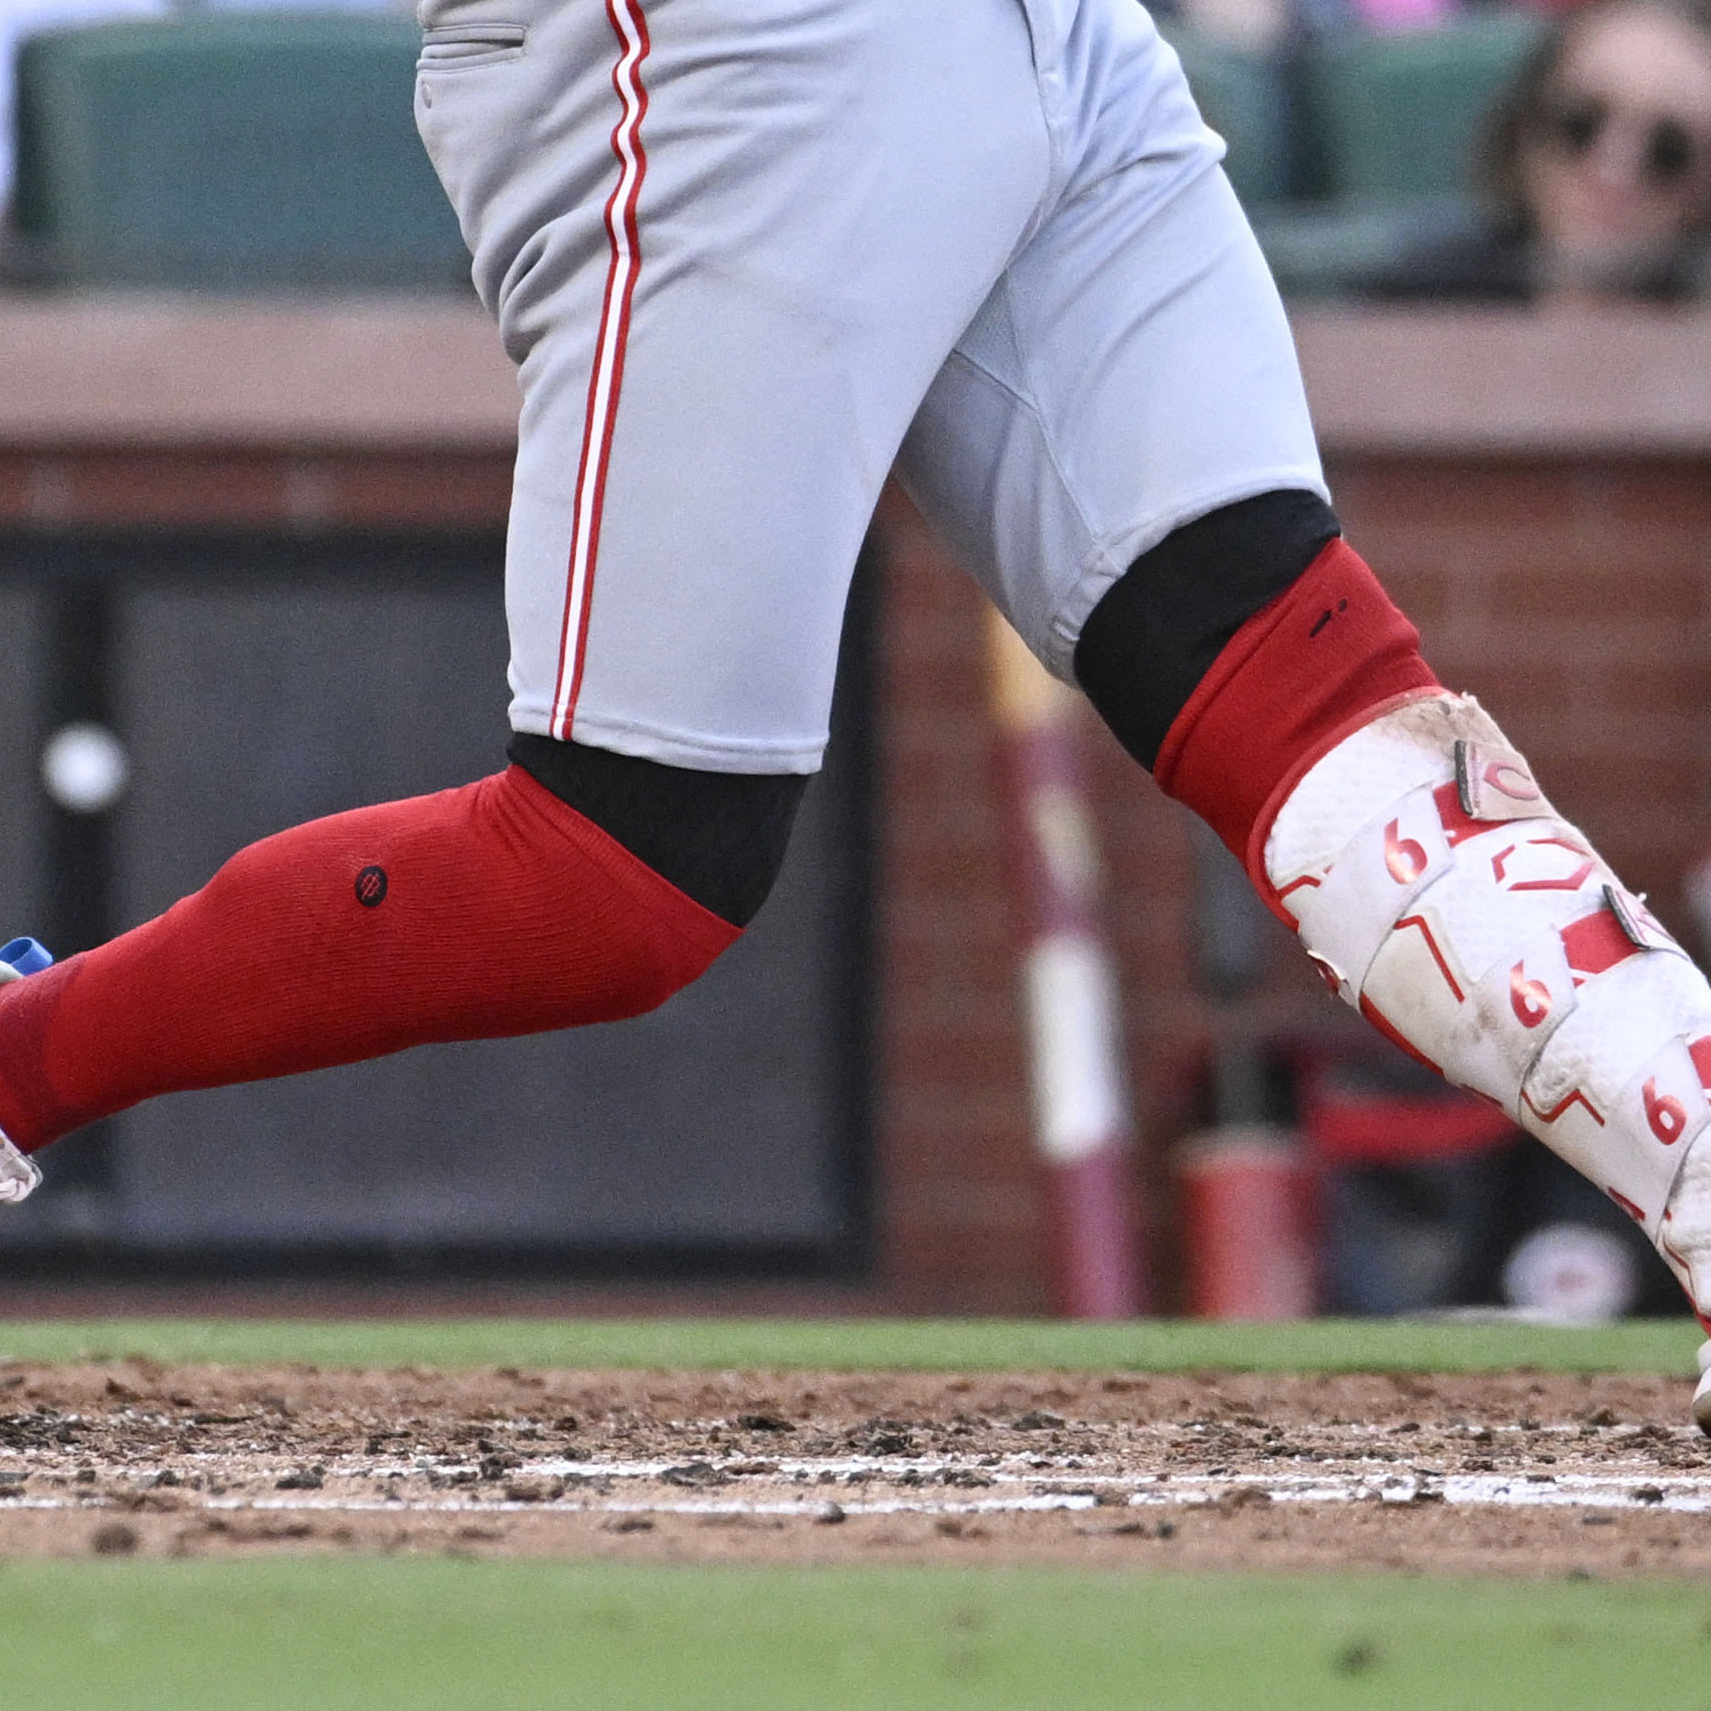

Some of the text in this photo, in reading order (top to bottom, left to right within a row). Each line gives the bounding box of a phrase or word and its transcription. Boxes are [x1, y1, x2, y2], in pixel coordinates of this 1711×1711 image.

[1384, 817, 1428, 885] 6
[1509, 959, 1553, 1029] 6
[1642, 1076, 1687, 1146] 6
